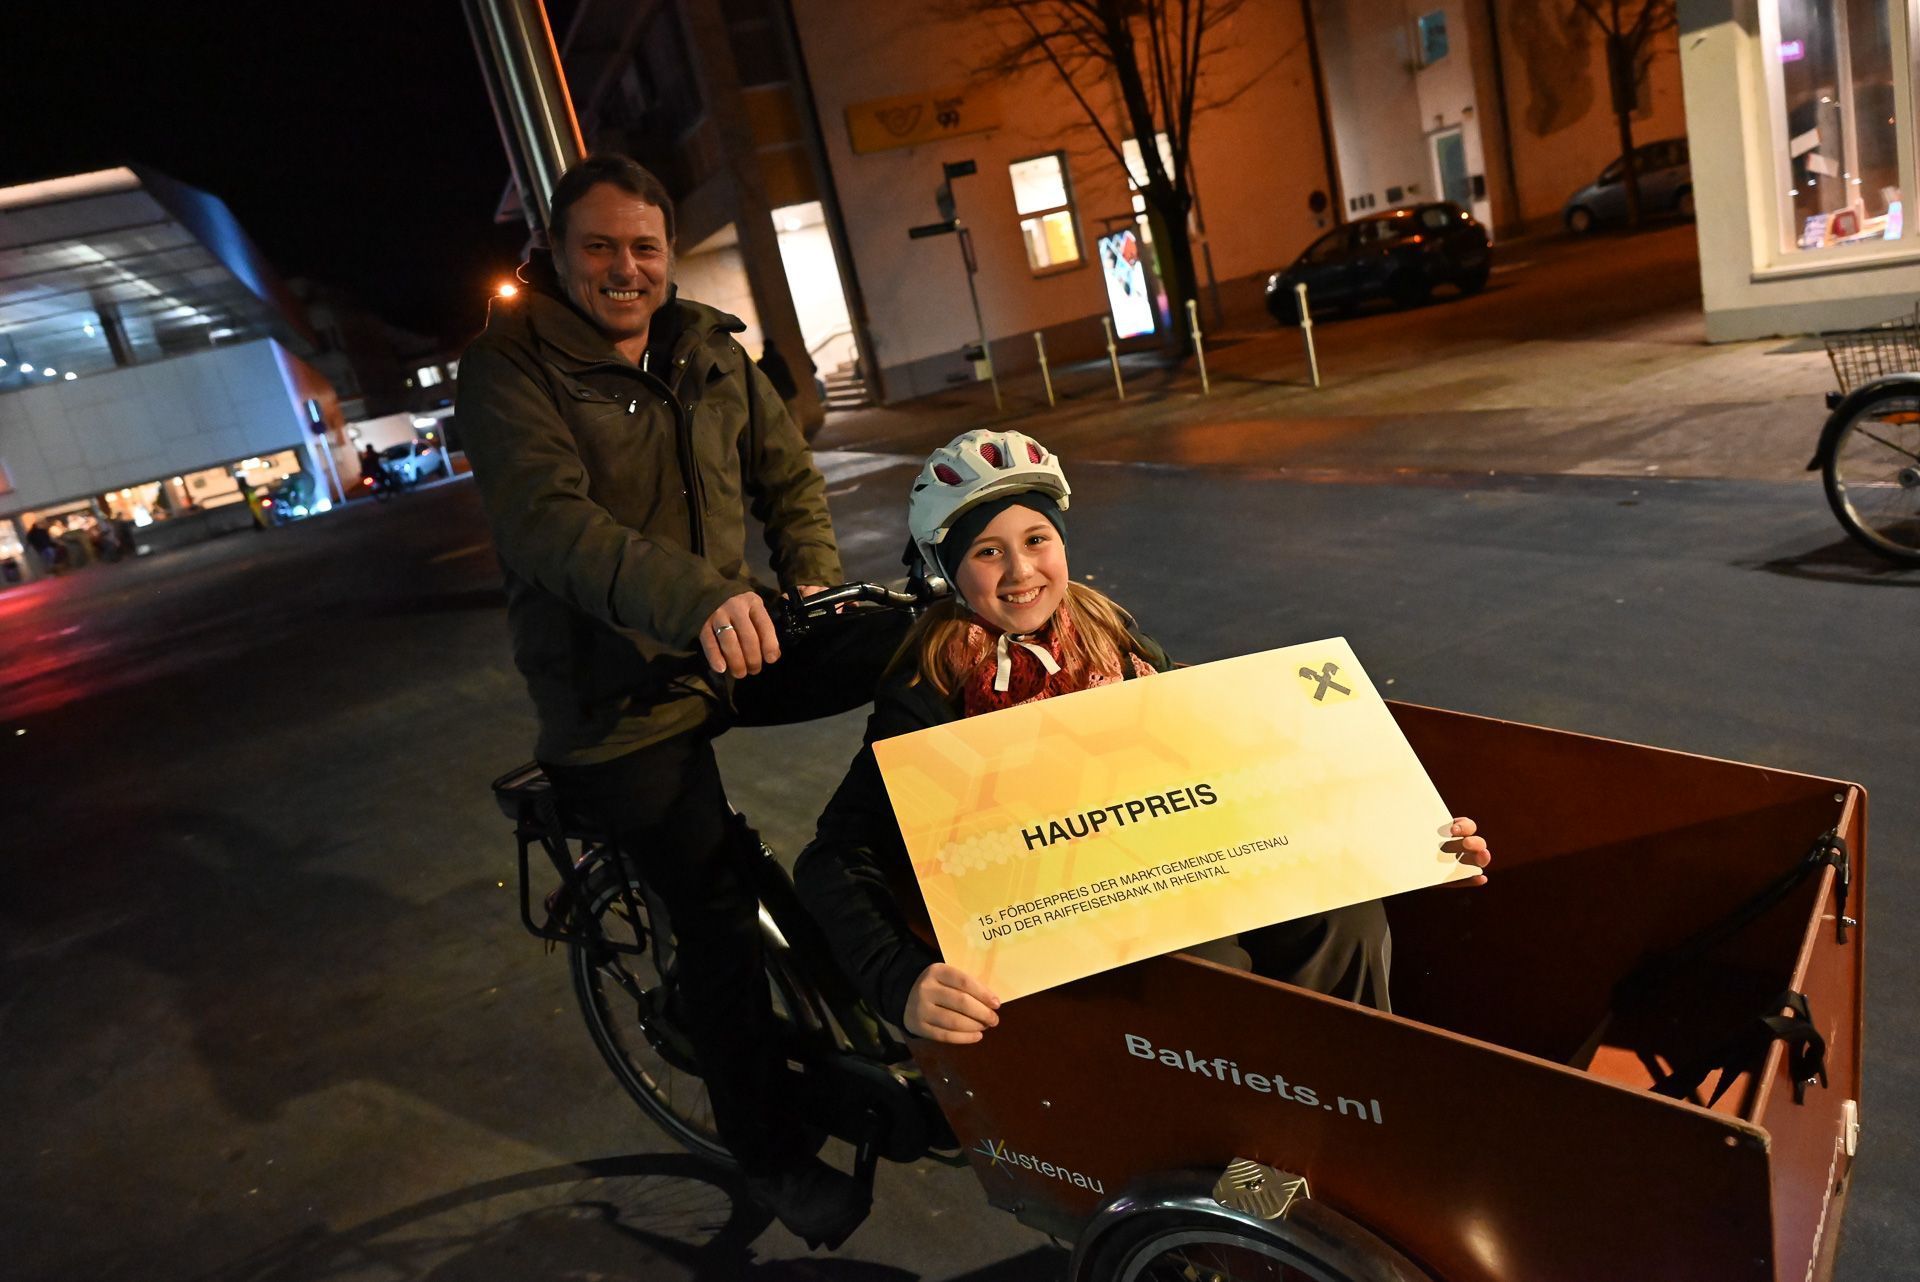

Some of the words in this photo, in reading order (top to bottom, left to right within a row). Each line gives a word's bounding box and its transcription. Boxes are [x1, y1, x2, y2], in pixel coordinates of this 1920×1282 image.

[1021, 783, 1218, 851] HAUPTPREIS
[978, 914, 997, 927] 15.
[999, 886, 1089, 920] FÖRDERPREIS
[1091, 878, 1119, 894] DER
[1119, 850, 1226, 885] MARKTGEMEINDE
[1227, 835, 1289, 859] LUSTENAU
[982, 924, 1012, 941] UND
[1014, 915, 1043, 931] DER
[1044, 884, 1152, 922] RAIFFEISENBANK
[1152, 879, 1169, 892] IM
[1170, 865, 1230, 887] RHEINTAL
[1124, 1033, 1383, 1125] Bakfiets.nl
[985, 1138, 1105, 1195] Lustenau
